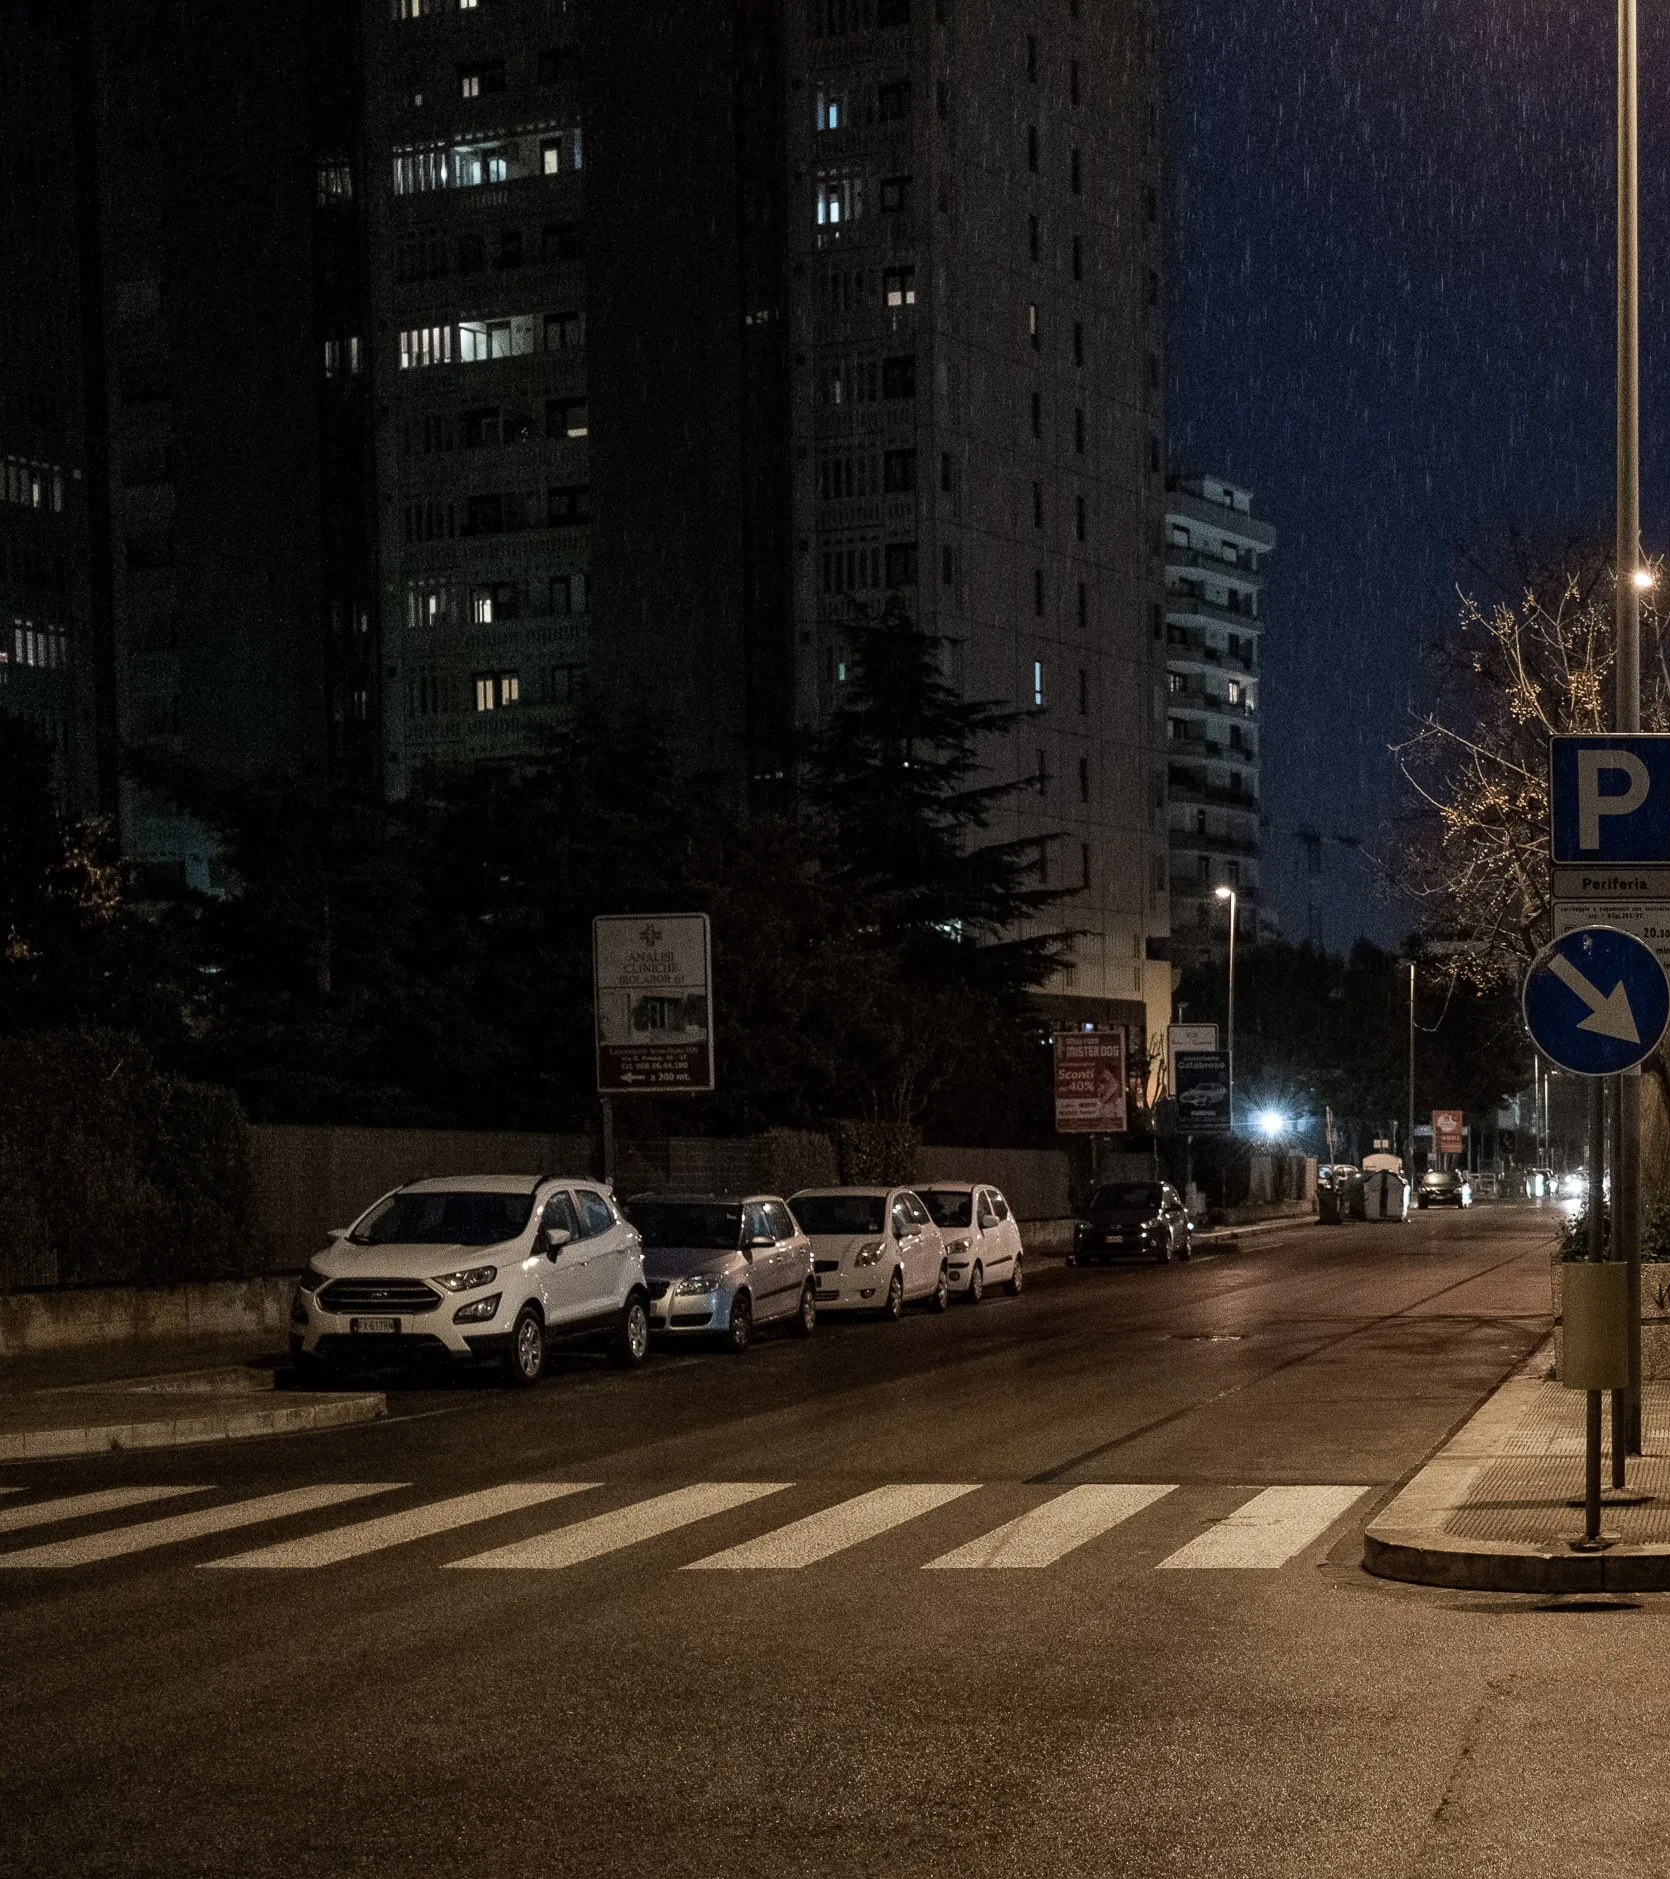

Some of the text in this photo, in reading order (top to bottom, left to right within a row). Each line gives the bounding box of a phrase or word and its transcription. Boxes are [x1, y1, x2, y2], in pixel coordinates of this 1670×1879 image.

[1578, 749, 1650, 850] P
[1582, 877, 1648, 891] Periferia
[627, 951, 674, 962] ANALISI
[1066, 1045, 1119, 1057] MISTER DOG
[658, 1072, 675, 1081] 200
[1058, 1068, 1095, 1080] Sconti
